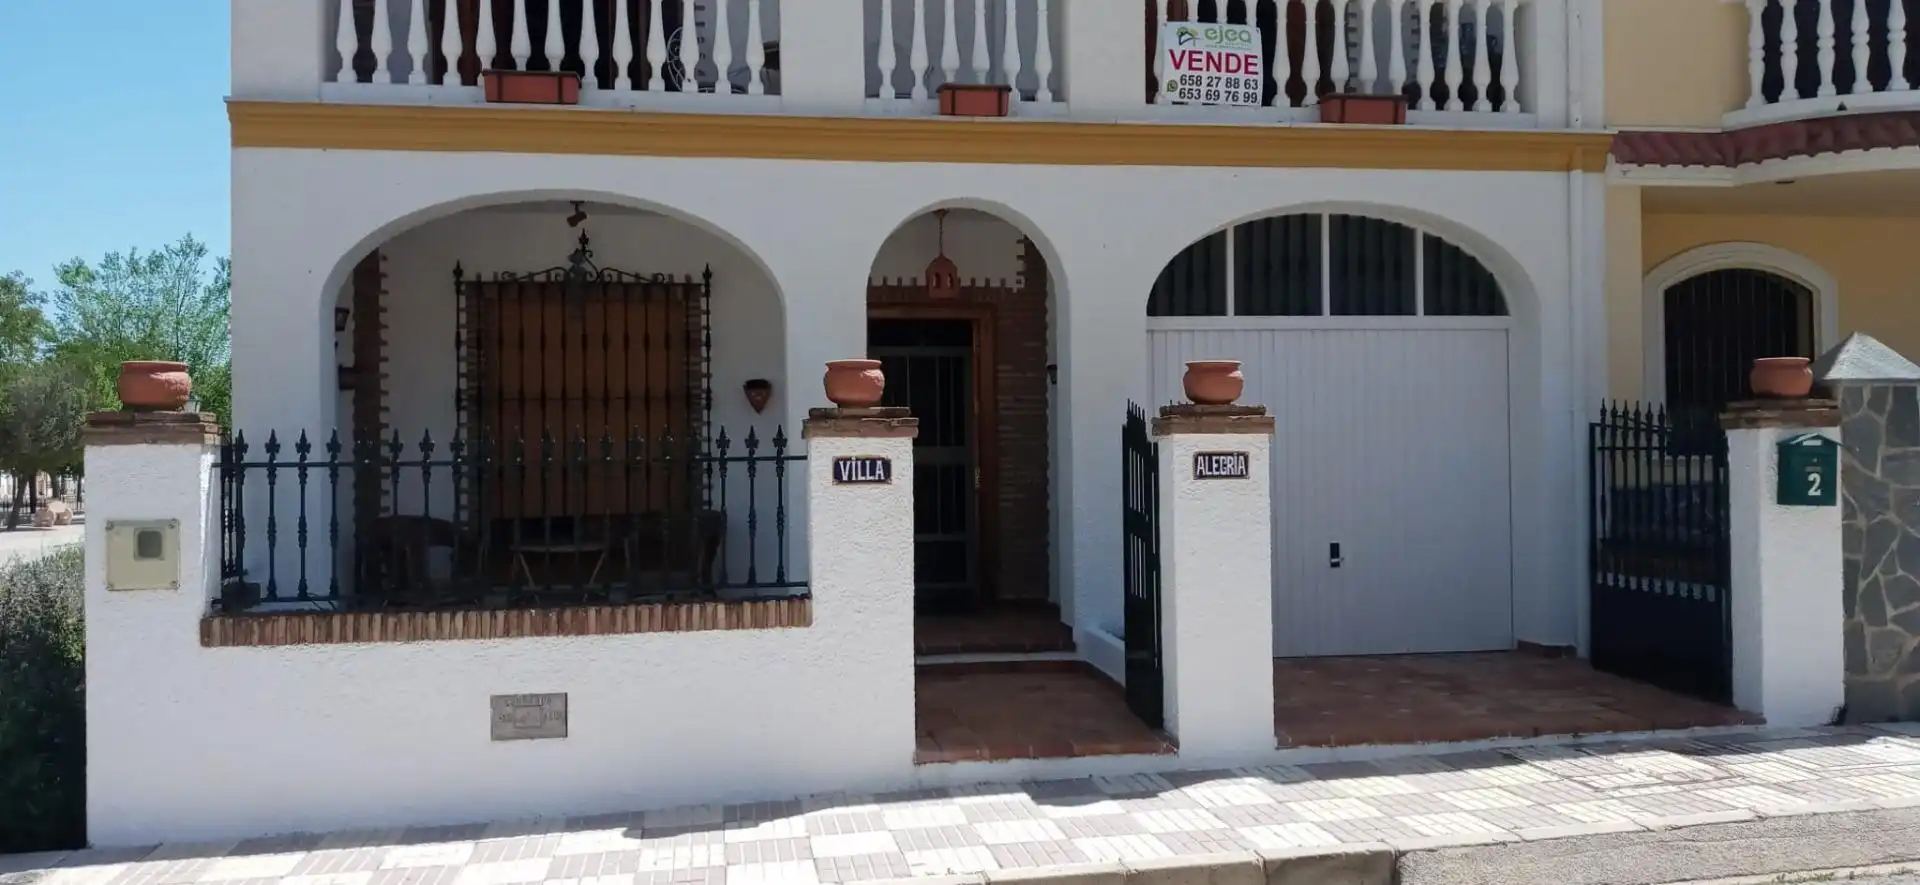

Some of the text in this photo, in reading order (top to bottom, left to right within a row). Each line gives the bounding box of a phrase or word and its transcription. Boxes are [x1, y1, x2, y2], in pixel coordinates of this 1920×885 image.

[1169, 48, 1259, 75] VENDE
[1180, 74, 1259, 90] 658 27 88 63
[1179, 87, 1258, 104] 653 69 76 99
[1807, 472, 1822, 496] 2
